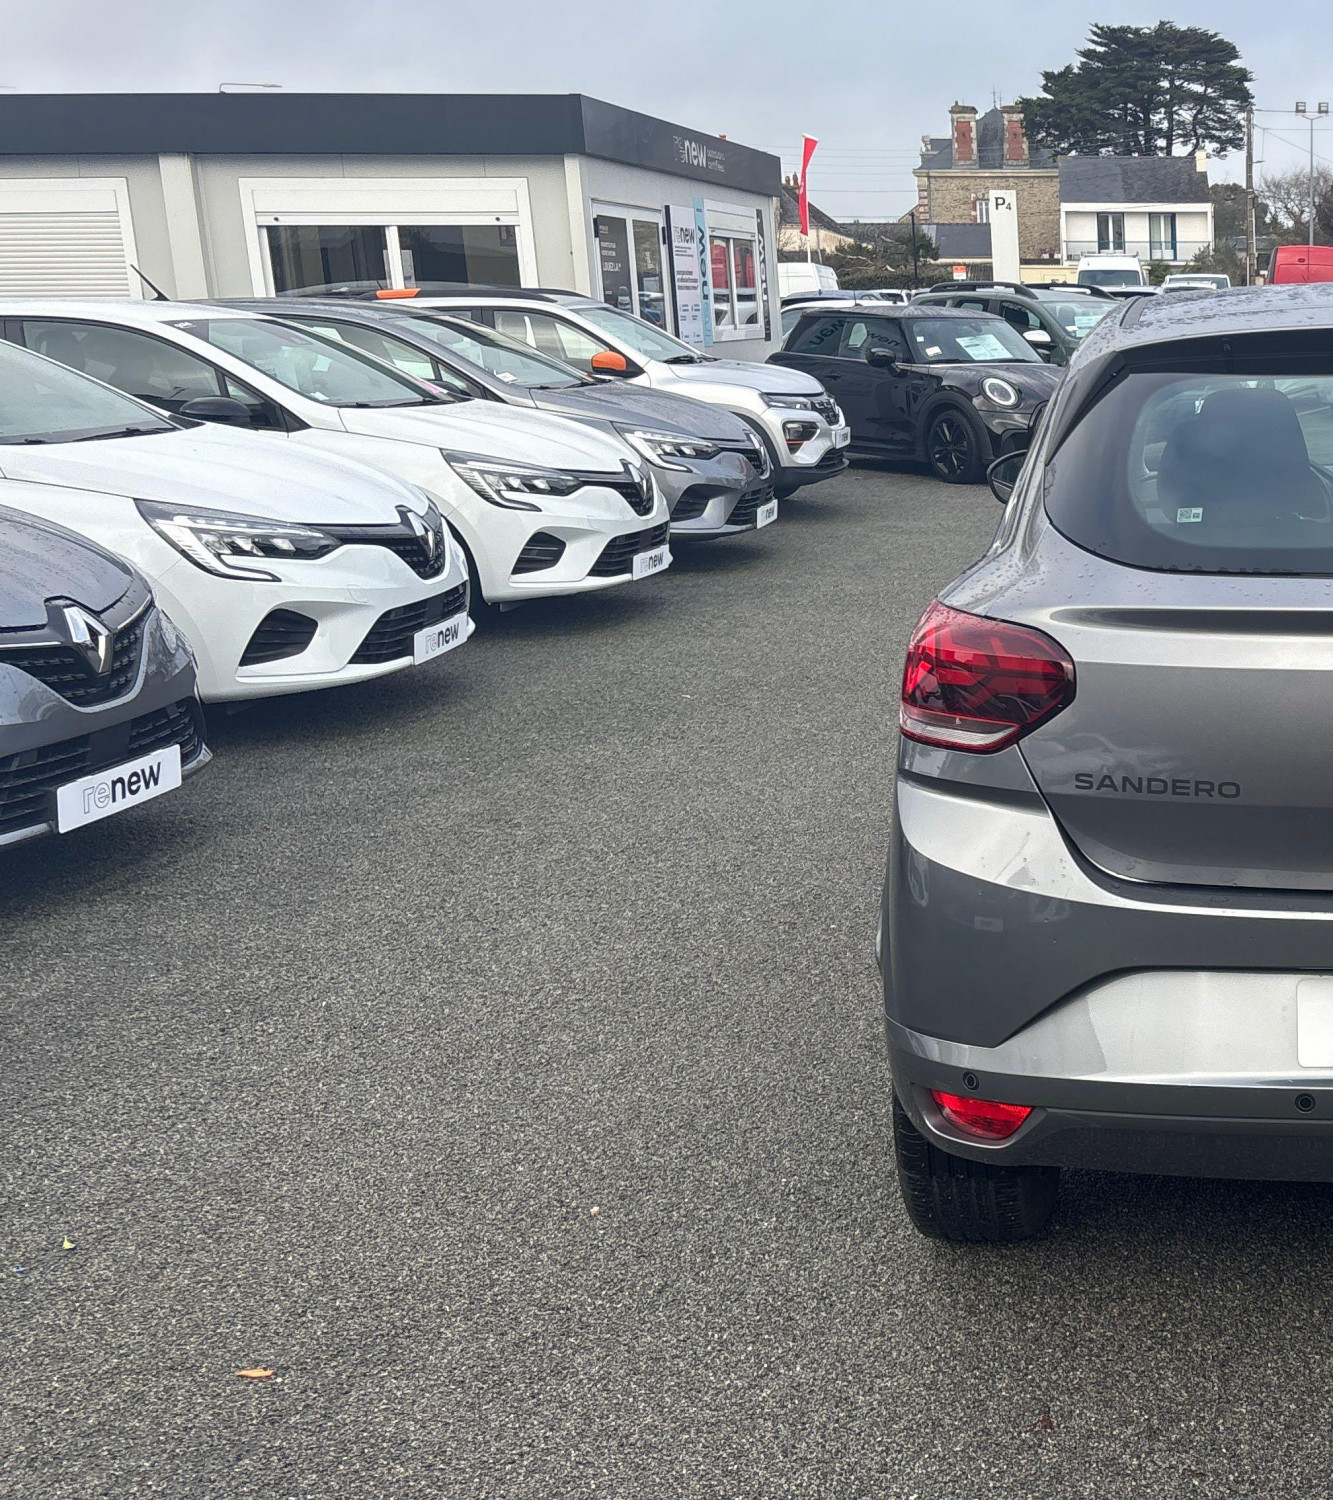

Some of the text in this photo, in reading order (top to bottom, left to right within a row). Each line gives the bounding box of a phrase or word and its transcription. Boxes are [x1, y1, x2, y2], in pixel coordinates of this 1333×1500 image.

[994, 197, 1012, 211] P4
[640, 552, 663, 573] renew
[425, 622, 459, 654] renew
[83, 762, 161, 814] renew
[1074, 772, 1241, 799] SANDERO
